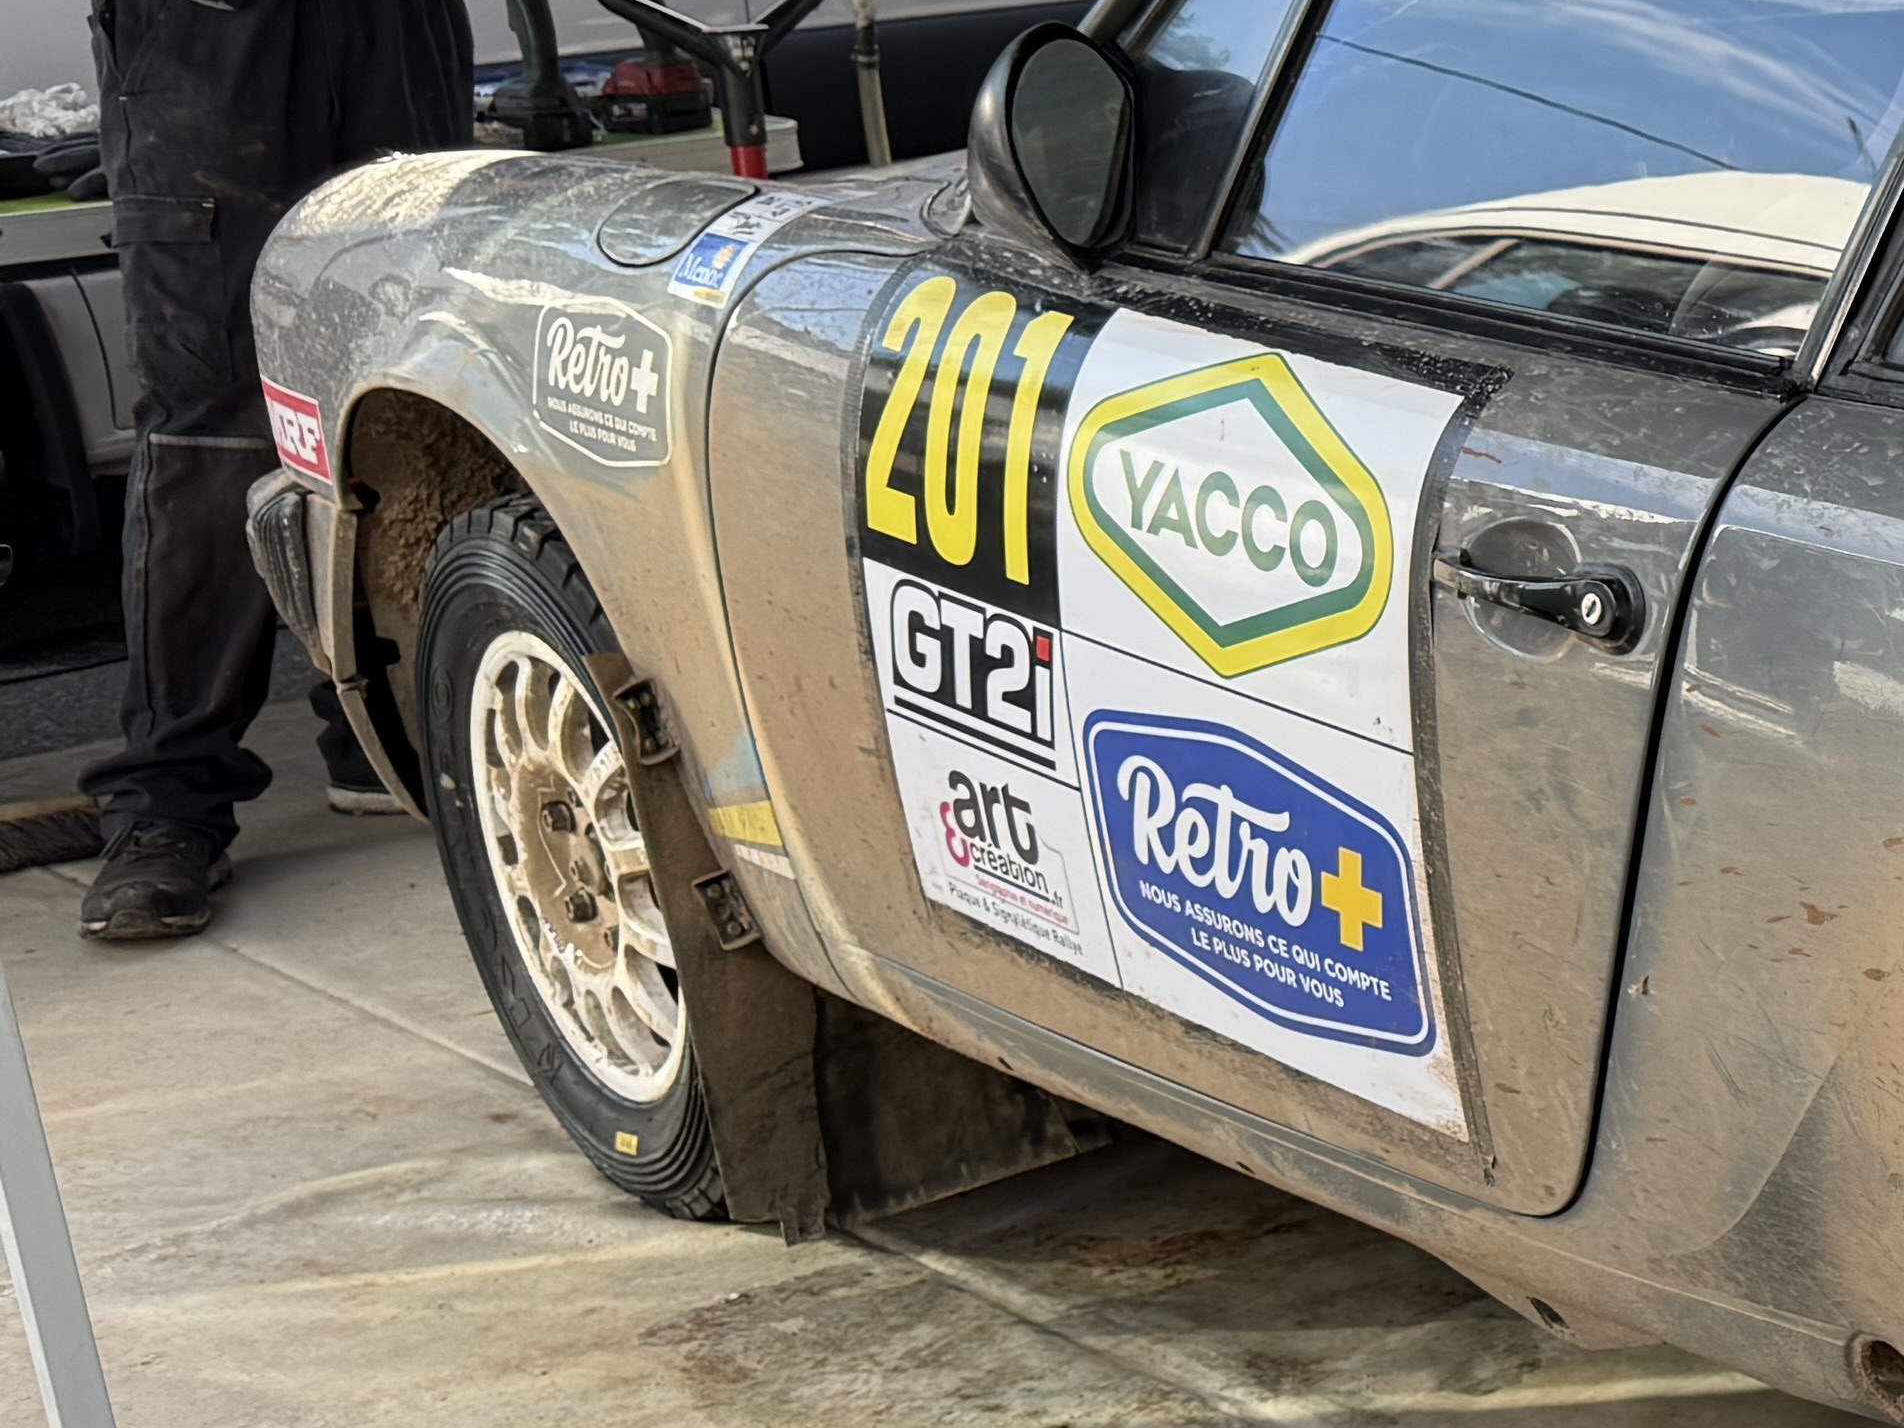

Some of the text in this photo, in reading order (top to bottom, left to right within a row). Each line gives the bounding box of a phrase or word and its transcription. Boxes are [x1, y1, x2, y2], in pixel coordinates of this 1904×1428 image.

[865, 275, 1074, 586] 201
[1118, 449, 1339, 588] YACCO
[891, 582, 1053, 744] GT2i
[947, 770, 1040, 865] art
[1139, 879, 1393, 1002] NOUS ASSURONS CE QUI COMPTE
[1191, 927, 1345, 1008] LE PLUS POUR VOUS
